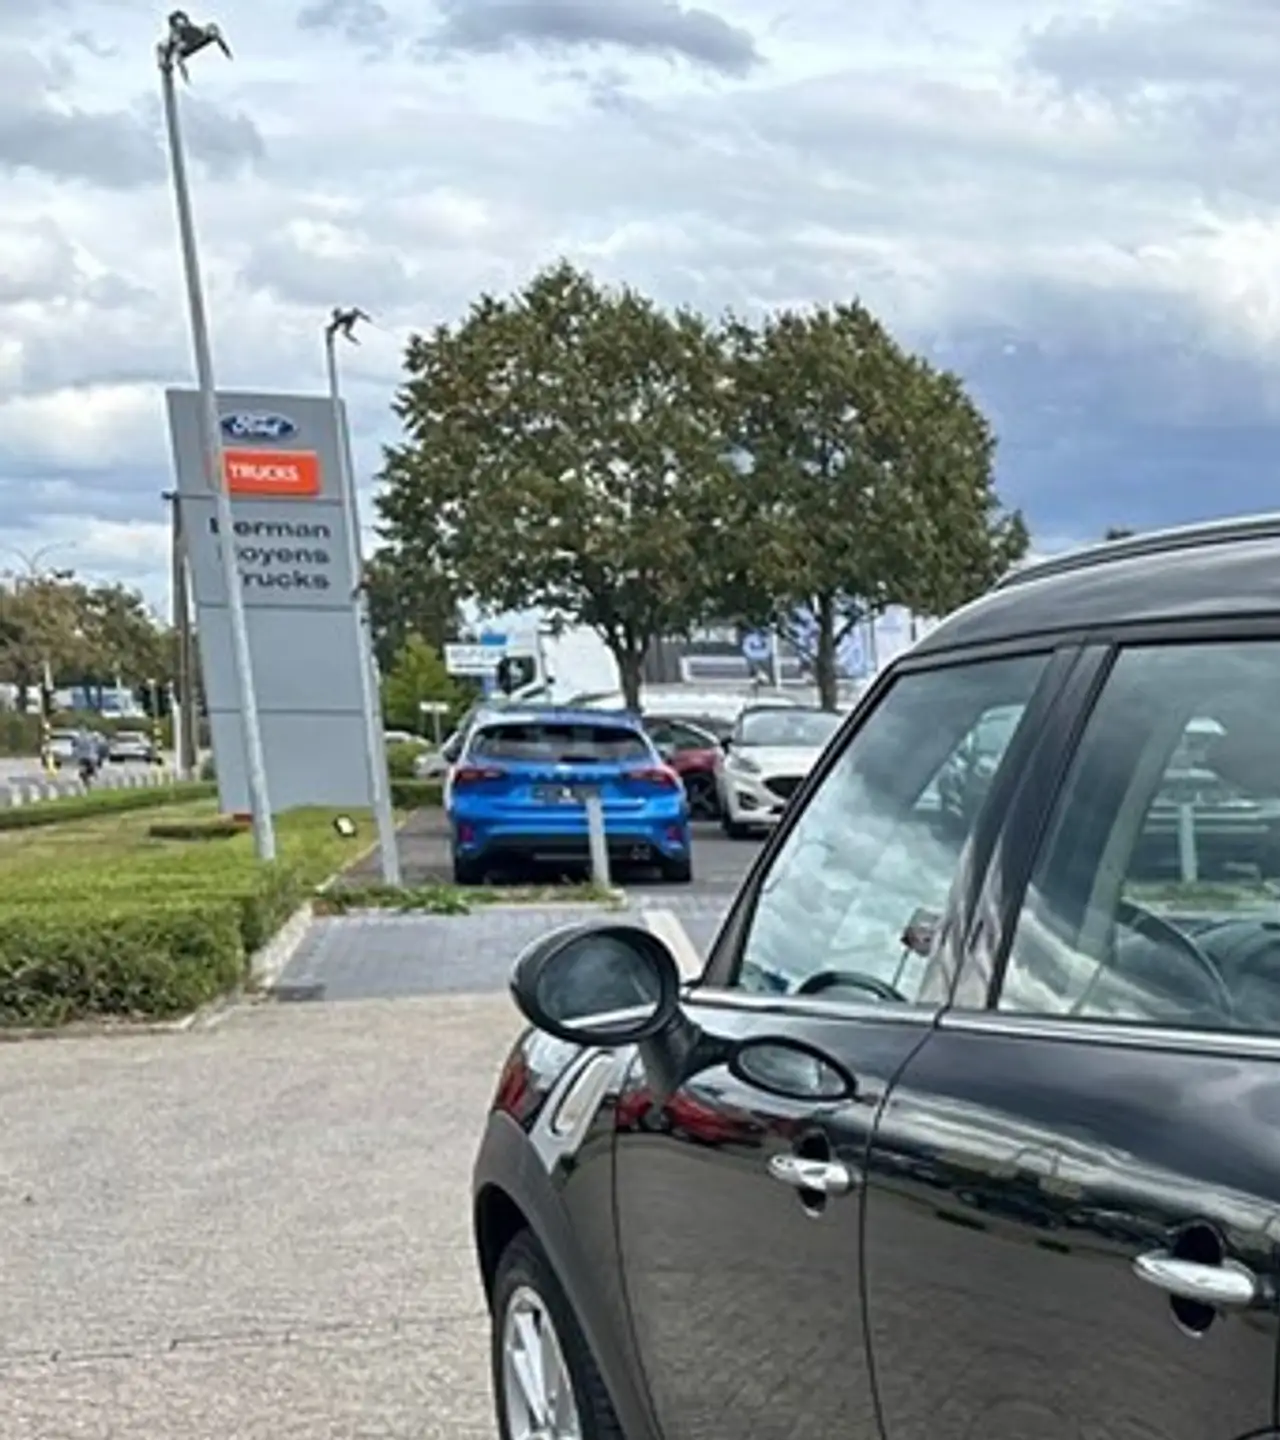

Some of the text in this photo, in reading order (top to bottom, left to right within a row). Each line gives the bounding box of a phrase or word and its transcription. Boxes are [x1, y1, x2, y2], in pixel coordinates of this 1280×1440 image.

[228, 461, 300, 482] TRUCKS
[217, 545, 331, 567] oyens
[237, 568, 331, 591] rucks
